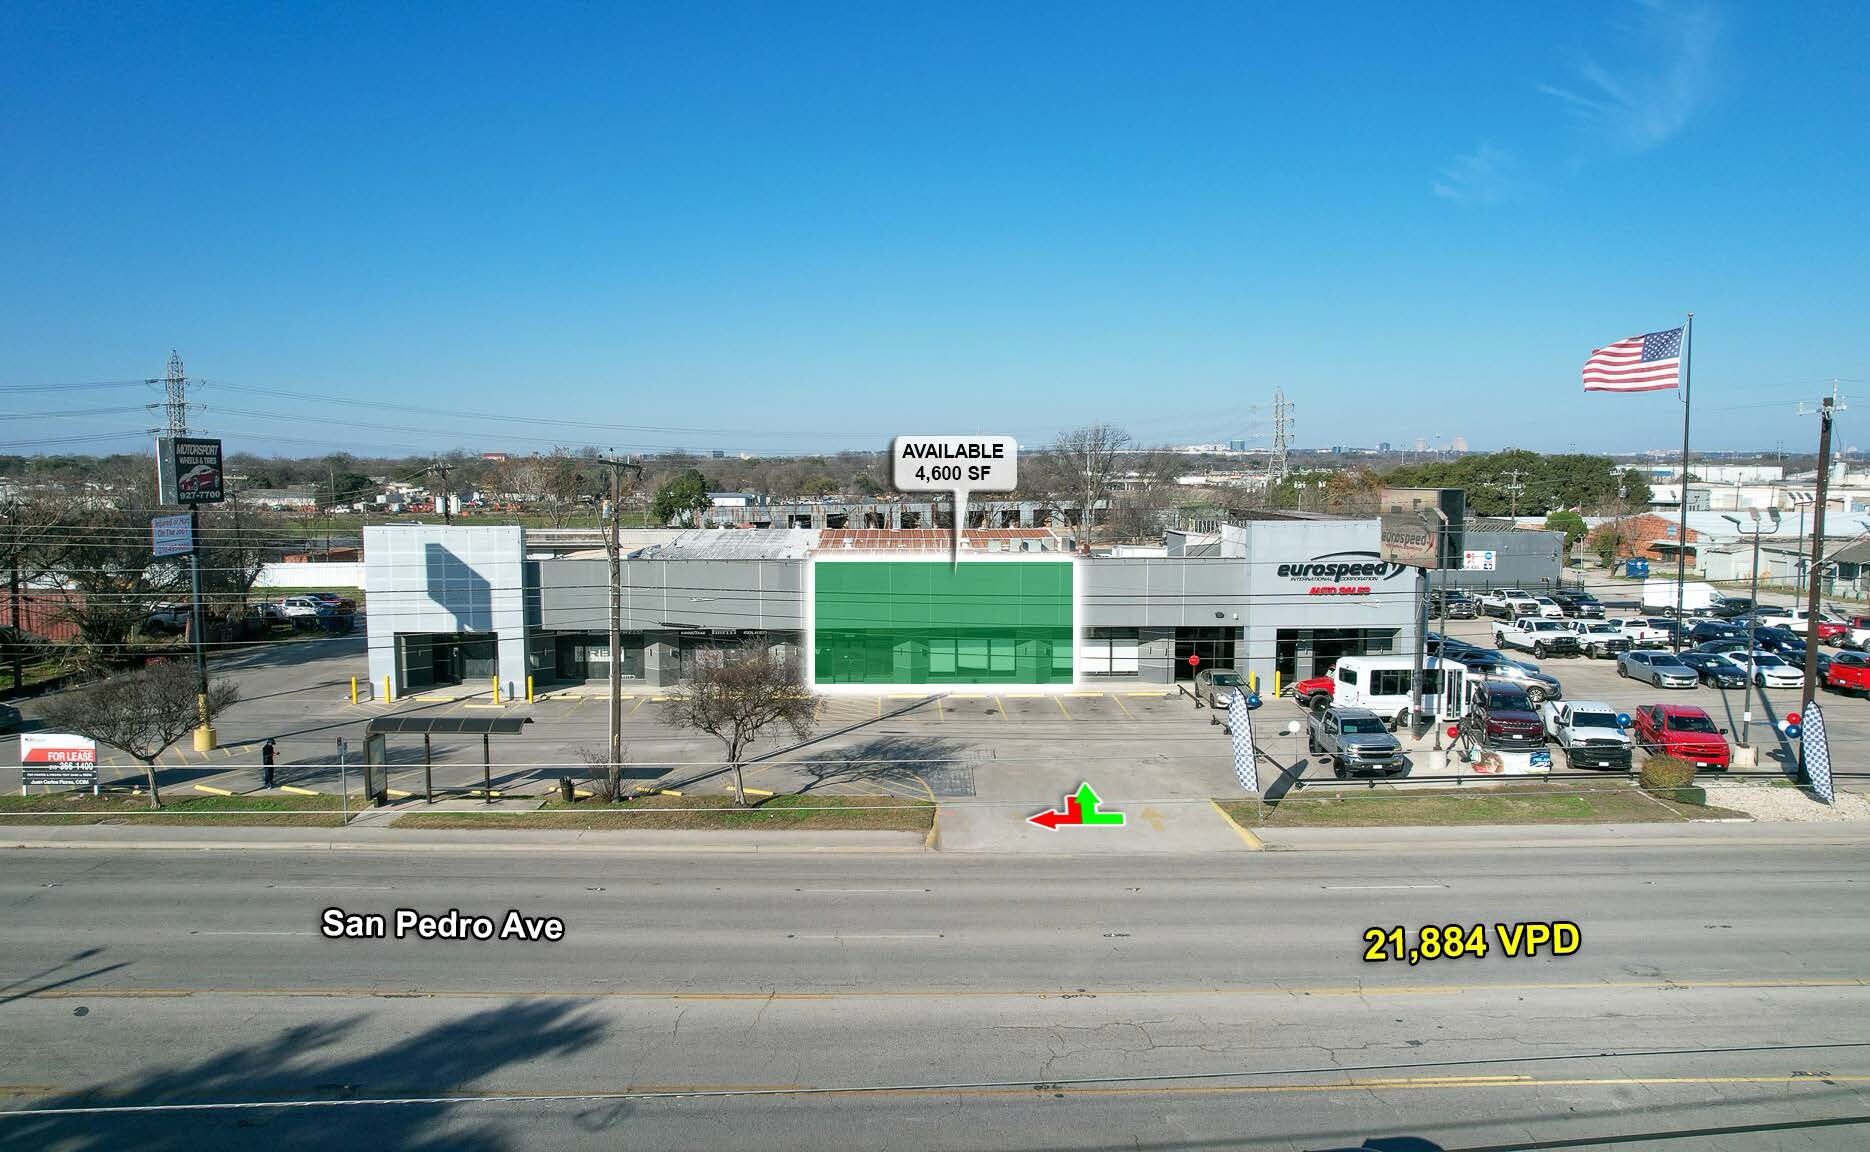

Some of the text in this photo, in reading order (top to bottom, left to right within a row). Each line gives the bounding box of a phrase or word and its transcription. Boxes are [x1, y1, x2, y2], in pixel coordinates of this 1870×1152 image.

[176, 444, 218, 455] MOTORSPORT
[179, 457, 198, 465] WHEELS
[204, 457, 217, 465] TIRES
[180, 491, 220, 499] 927-7700
[1381, 530, 1427, 549] eurospeed
[1277, 561, 1389, 583] eurospeed
[1308, 586, 1337, 596] AUTO
[47, 752, 93, 761] FOR LEASE
